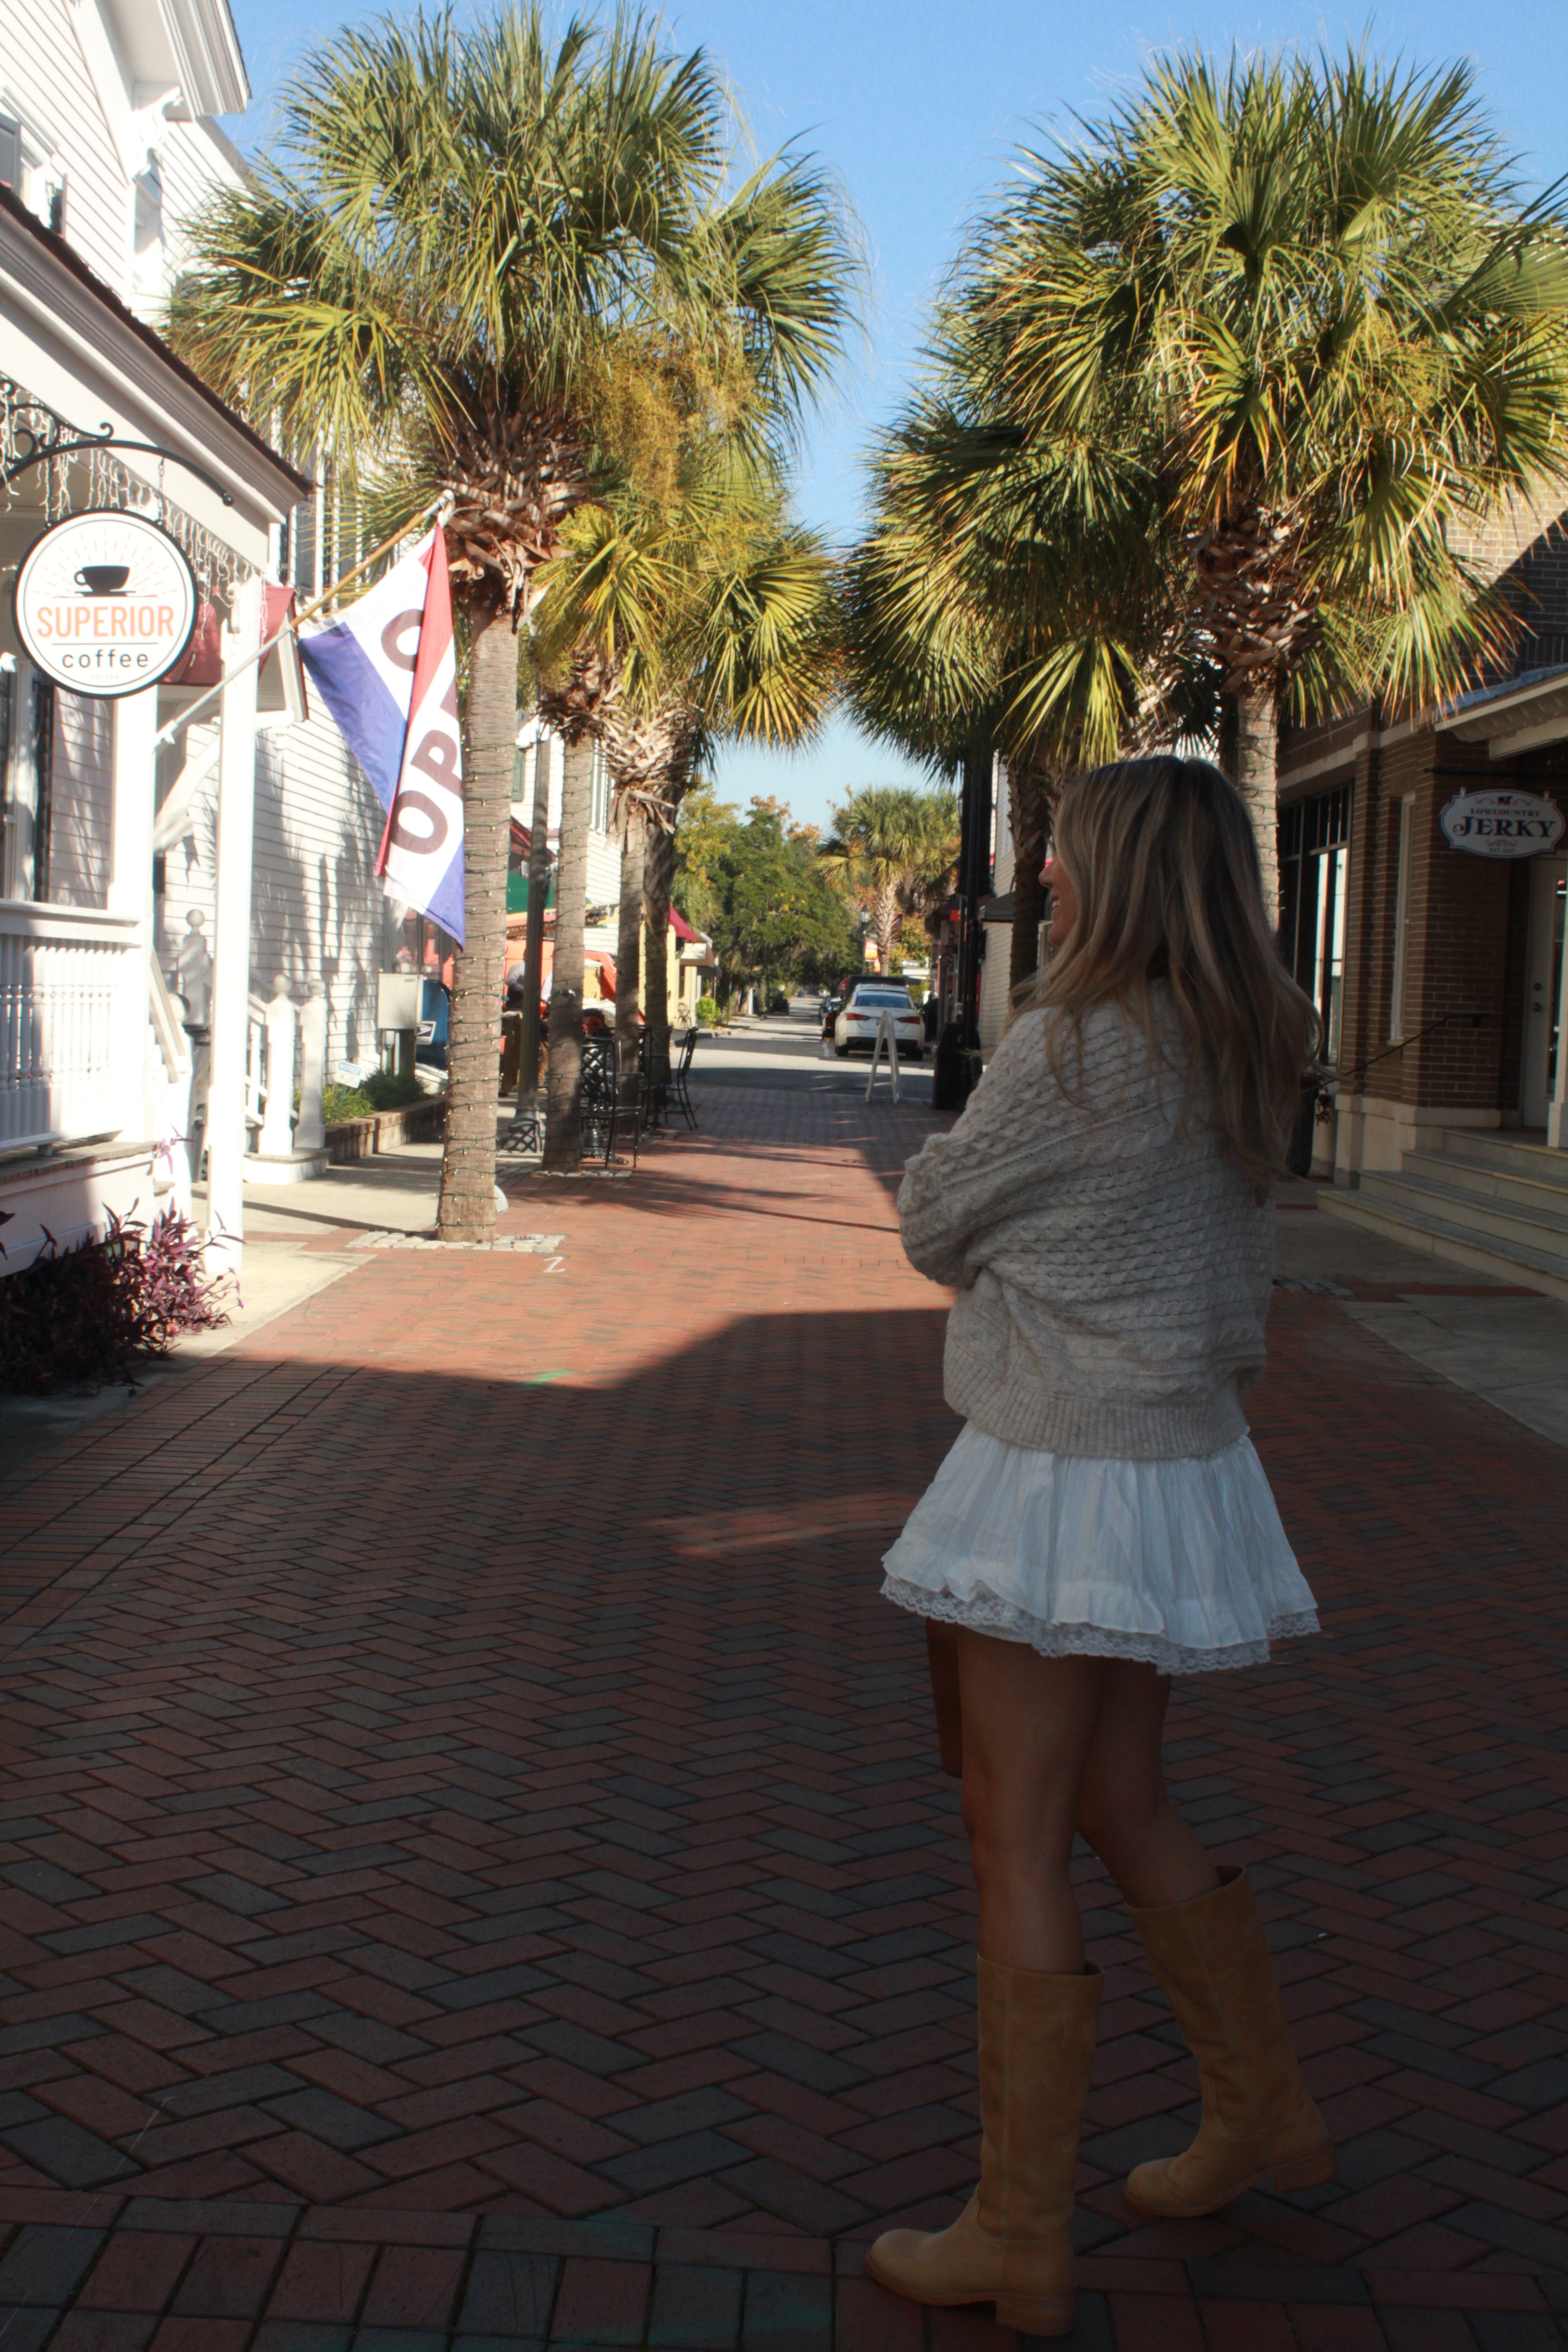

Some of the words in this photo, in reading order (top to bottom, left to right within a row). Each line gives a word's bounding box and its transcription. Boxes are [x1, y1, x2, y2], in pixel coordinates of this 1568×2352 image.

[37, 606, 174, 637] SUPERIOR
[63, 649, 148, 668] coffee
[1470, 808, 1541, 816] LOWCOUNTRY
[1452, 816, 1555, 838] JERKY
